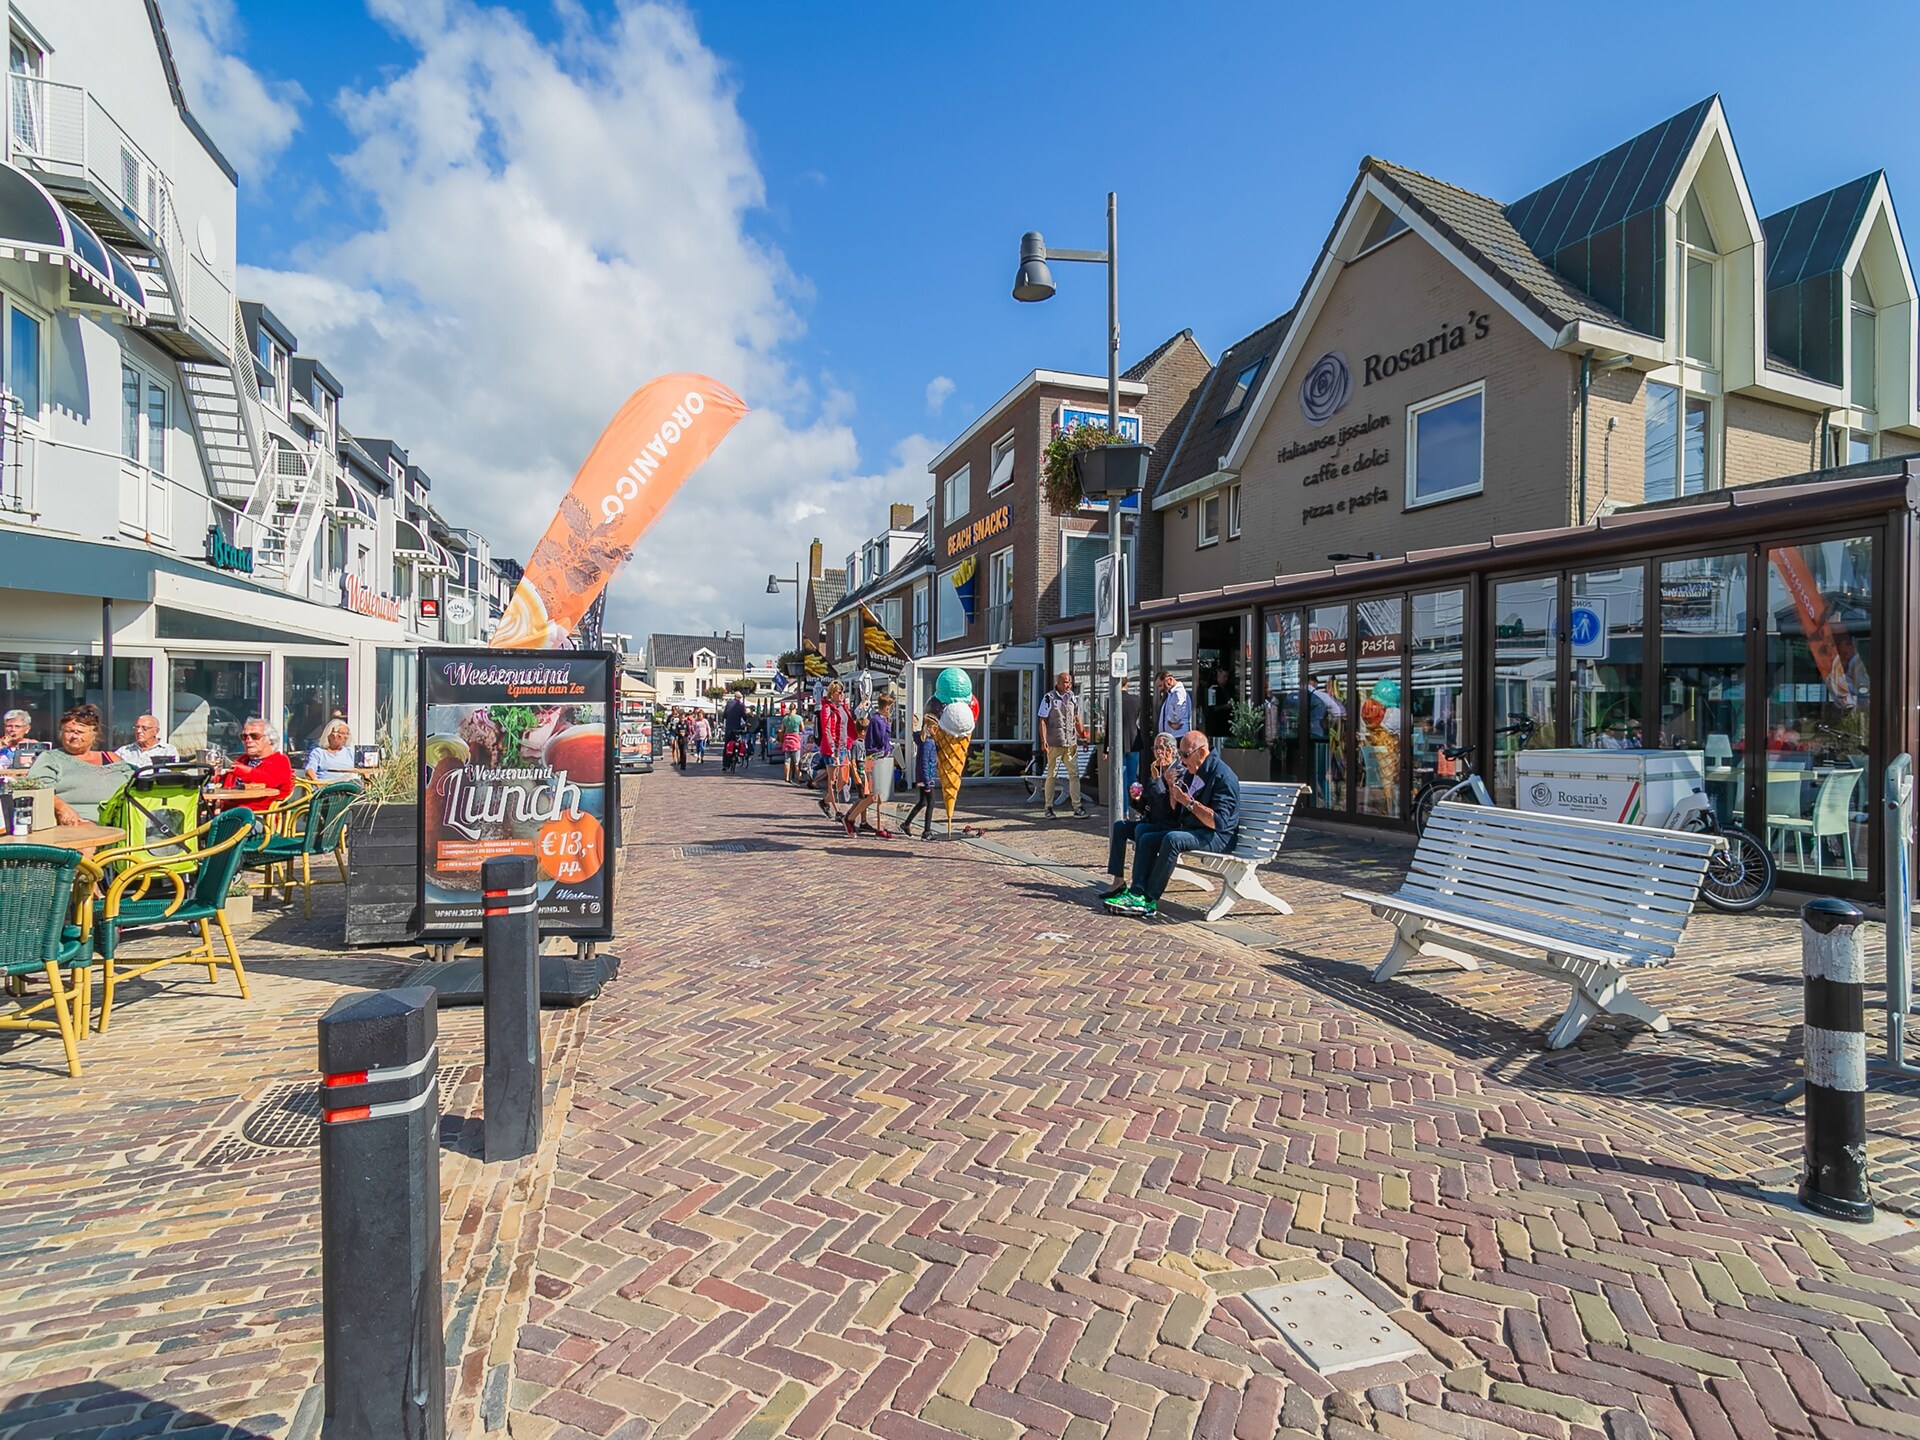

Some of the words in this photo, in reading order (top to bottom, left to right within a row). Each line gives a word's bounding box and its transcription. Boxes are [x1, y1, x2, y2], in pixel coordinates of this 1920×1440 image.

[1362, 310, 1490, 387] Rosaria's
[1088, 416, 1137, 441] BECH
[1277, 435, 1336, 463] italiaanse
[1338, 414, 1391, 449] ijssalon
[601, 391, 705, 522] ORGANICO
[1341, 464, 1350, 476] e
[1352, 449, 1390, 473] dolci
[1302, 501, 1335, 525] pizza
[1336, 500, 1346, 513] e
[1349, 486, 1389, 514] pasta
[948, 525, 972, 557] BEACH
[973, 505, 1009, 543] SNACKS
[347, 573, 400, 623] Westenwind
[1310, 641, 1337, 658] pizza
[1338, 642, 1346, 652] e
[1361, 636, 1396, 655] pasta
[443, 662, 571, 686] Westenwind
[507, 683, 547, 698] Egmond
[547, 684, 567, 694] aan
[568, 682, 585, 695] Zee
[620, 732, 648, 747] Lunch
[436, 768, 585, 841] Lunch
[1558, 790, 1608, 806] Rosaria's
[540, 831, 595, 857] €13,-
